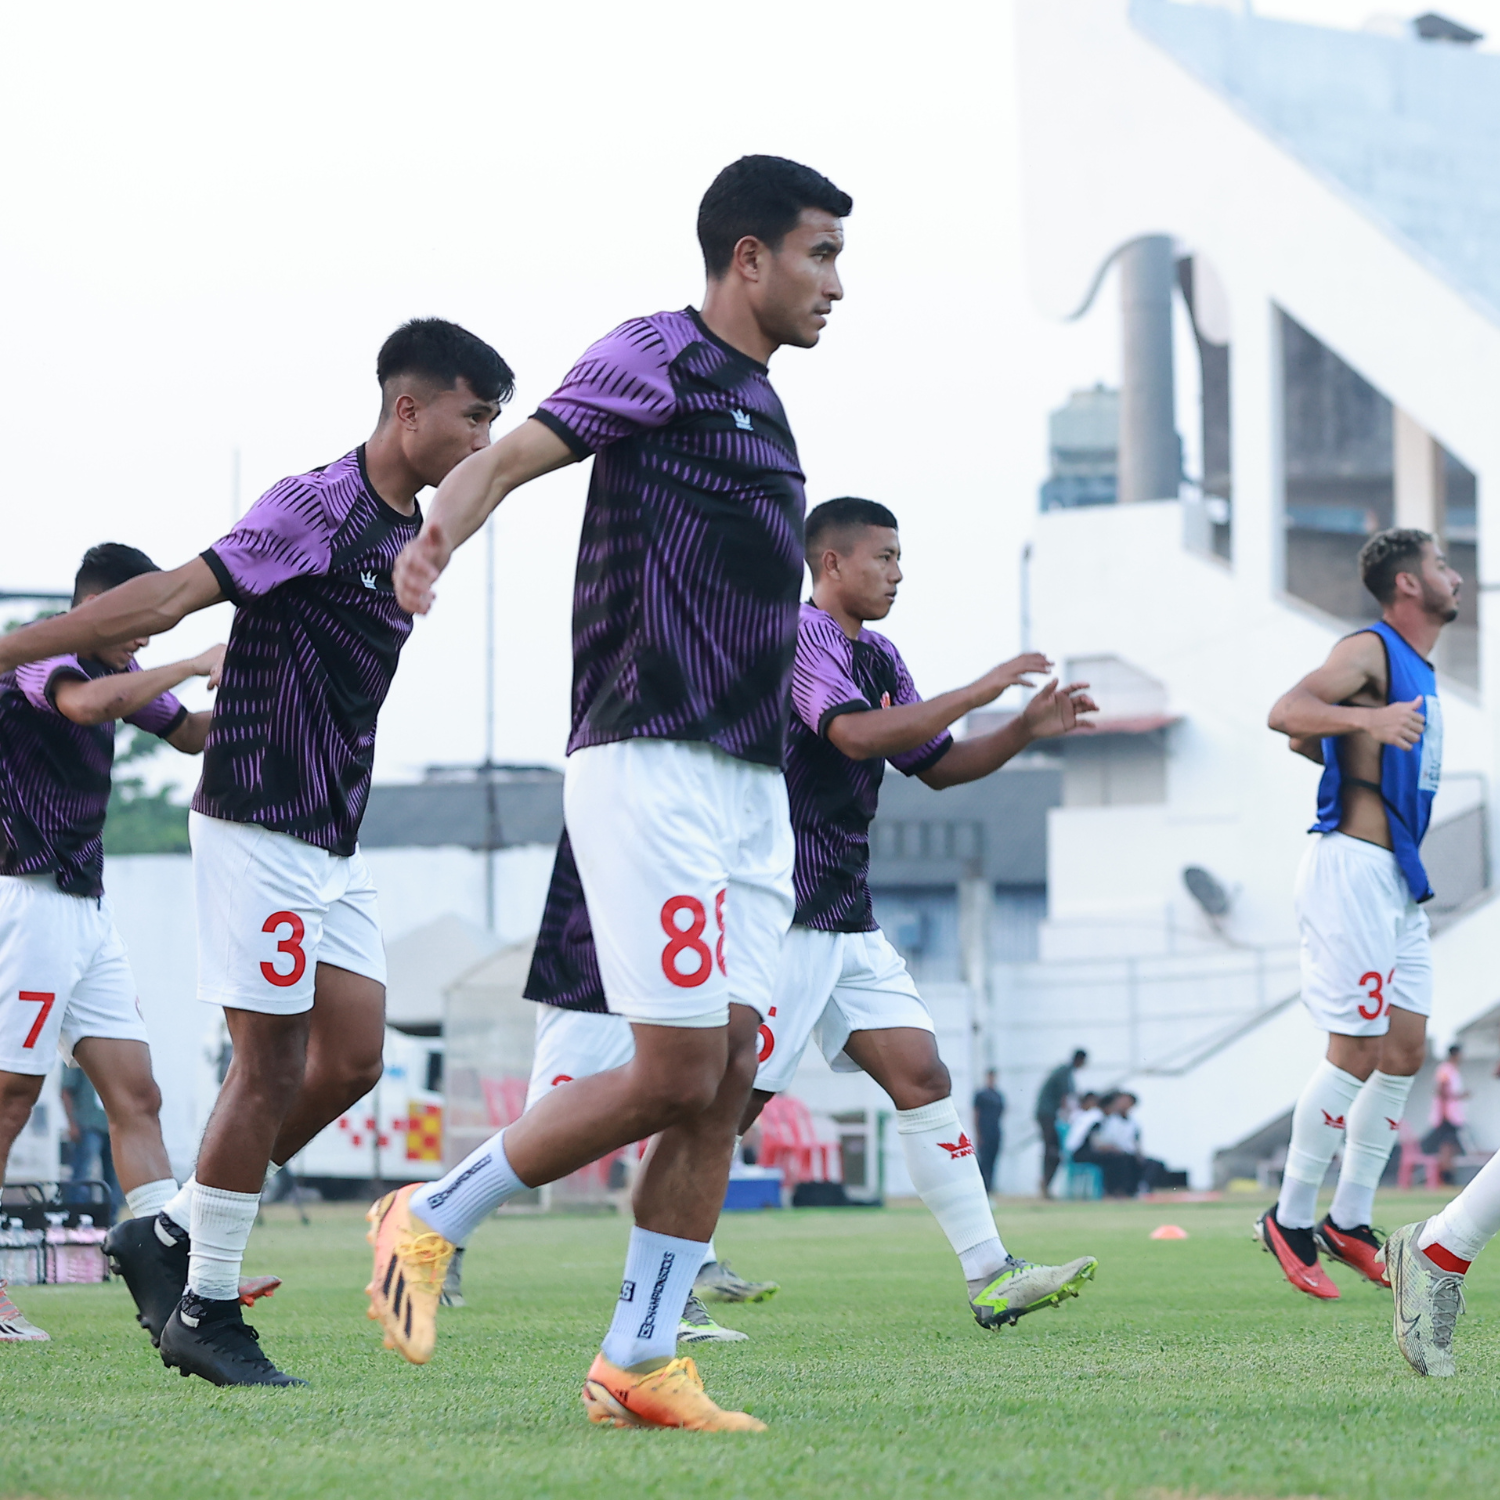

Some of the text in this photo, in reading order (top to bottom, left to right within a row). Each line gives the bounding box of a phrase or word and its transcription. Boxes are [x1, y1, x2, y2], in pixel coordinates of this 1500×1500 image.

[260, 910, 306, 987] 3
[660, 888, 727, 988] 8
[19, 991, 55, 1048] 7
[1358, 968, 1395, 1020] 3
